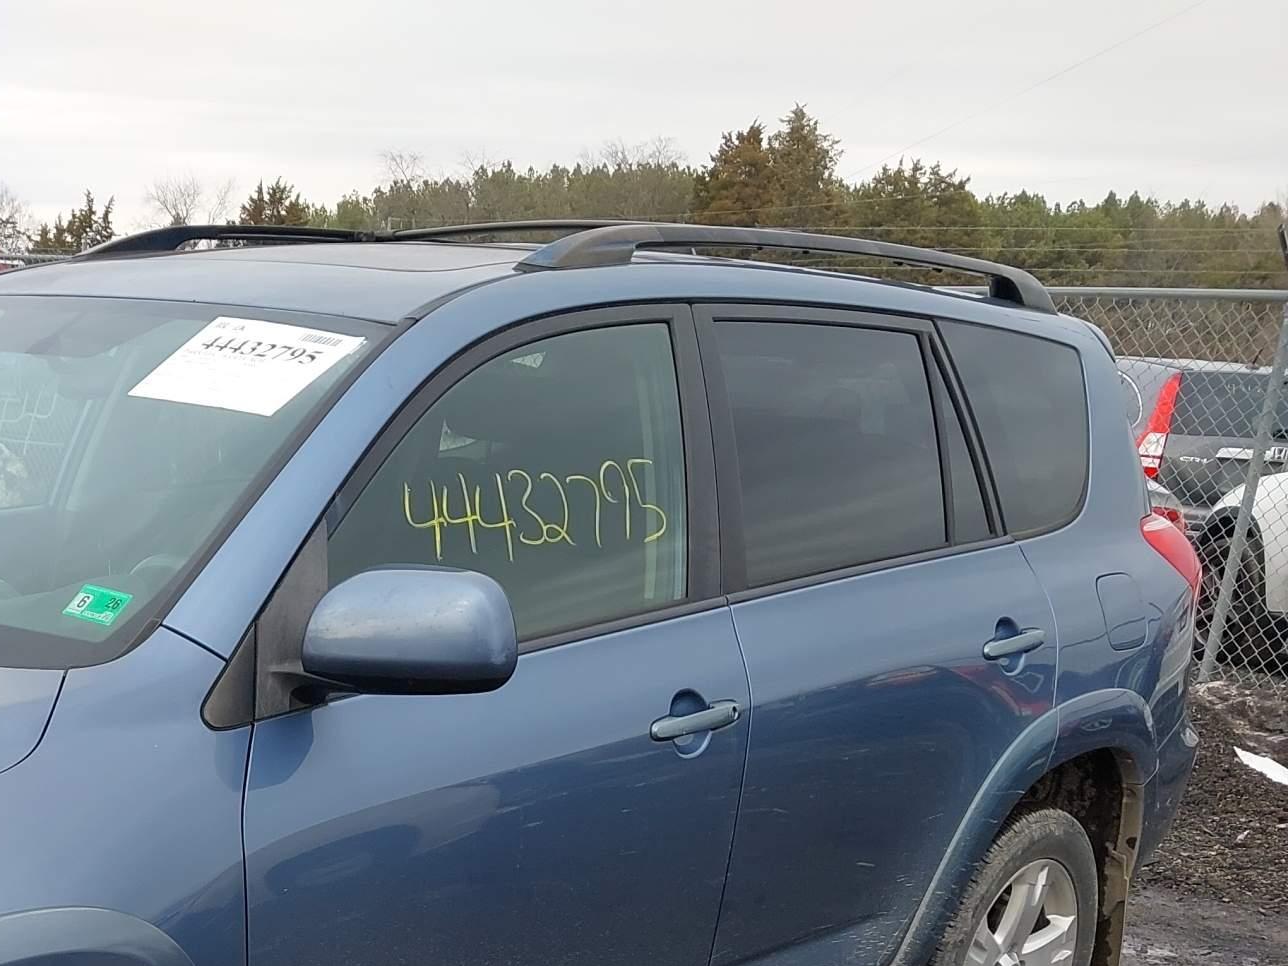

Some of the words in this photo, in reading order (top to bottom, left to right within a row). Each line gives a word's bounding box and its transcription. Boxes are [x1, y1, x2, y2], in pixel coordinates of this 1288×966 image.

[201, 336, 323, 364] 44432795
[401, 458, 666, 562] 44432795
[76, 595, 90, 608] 6
[104, 597, 123, 610] 26
